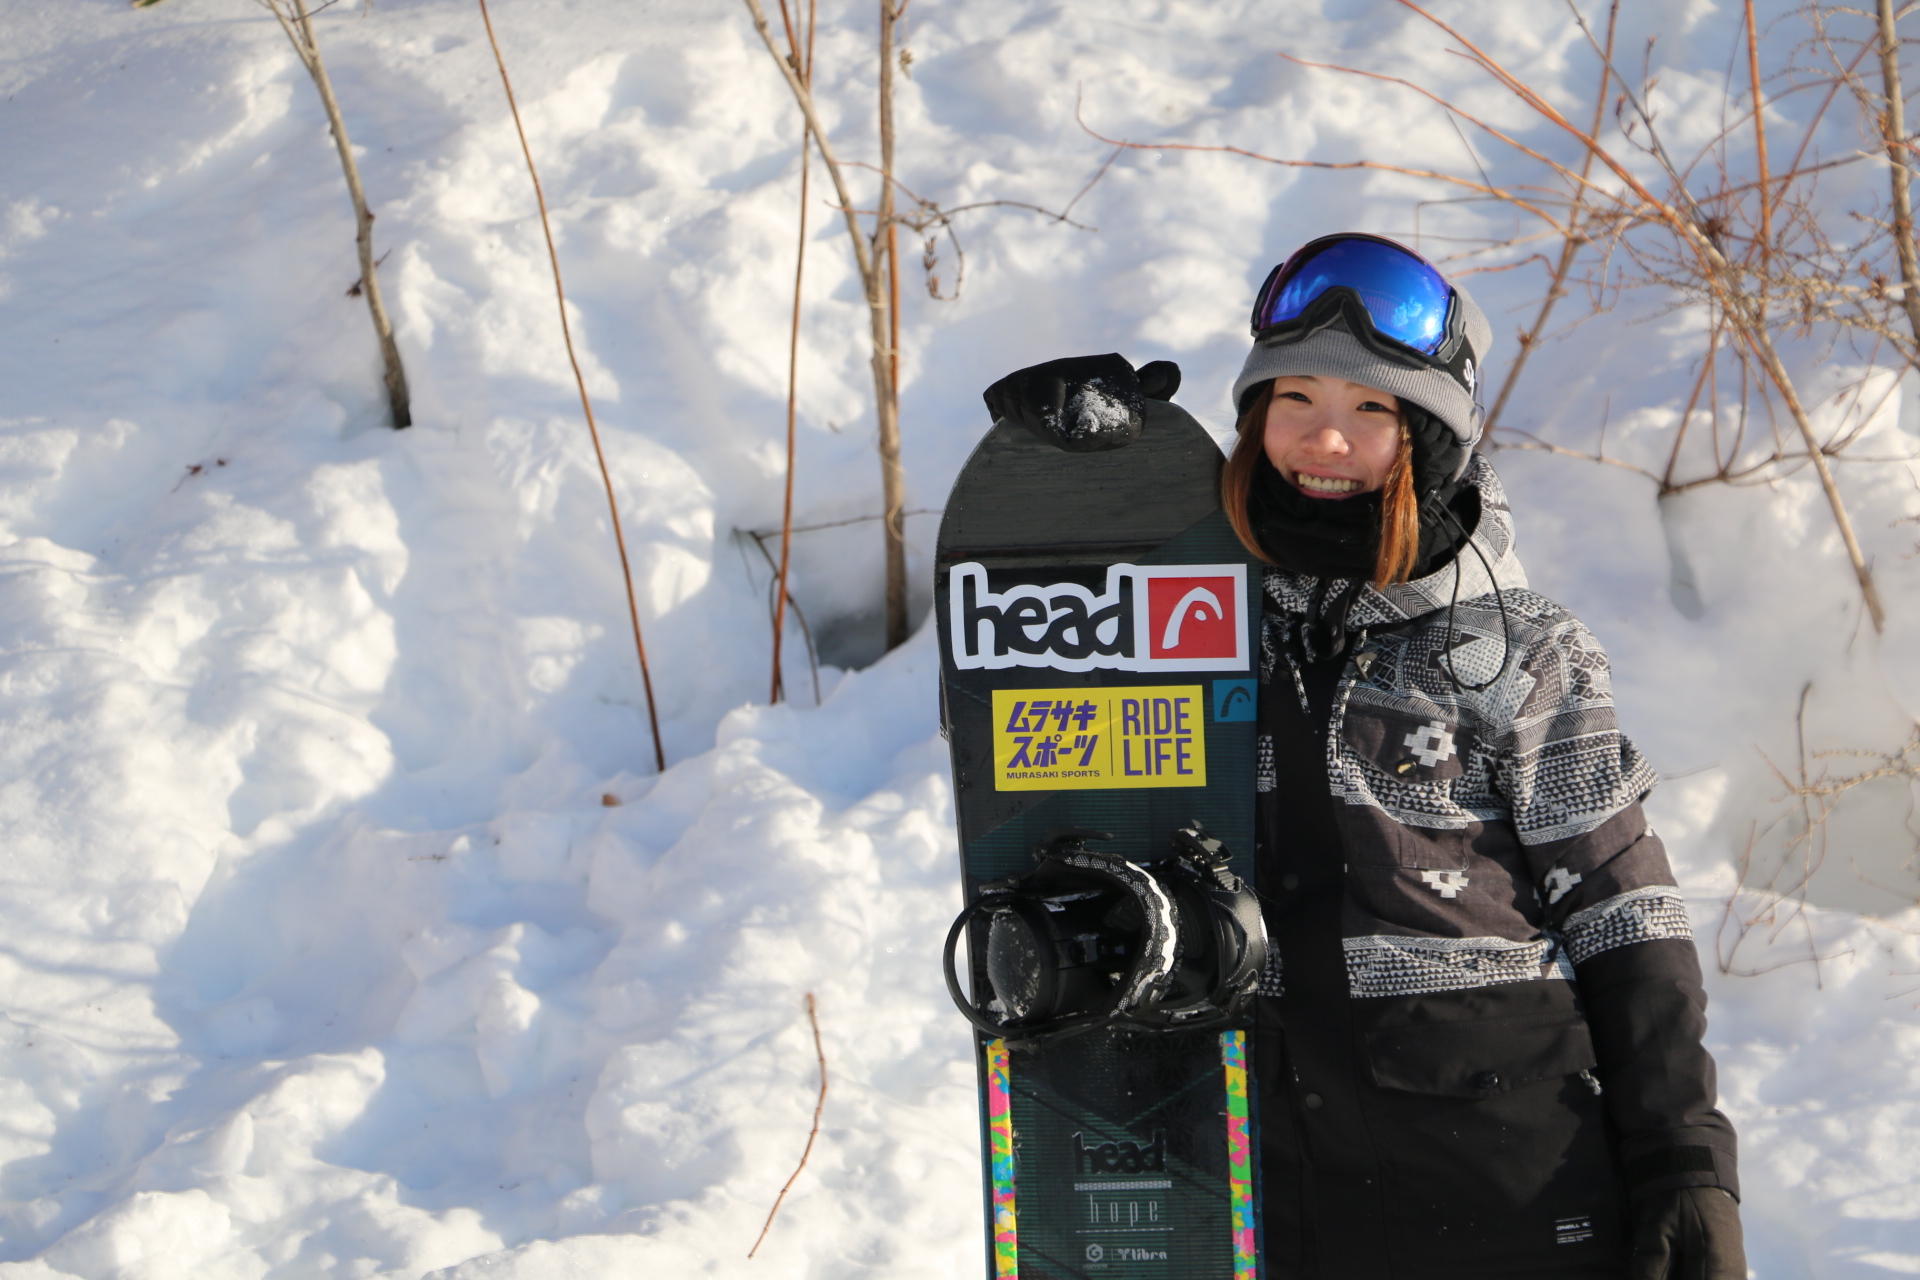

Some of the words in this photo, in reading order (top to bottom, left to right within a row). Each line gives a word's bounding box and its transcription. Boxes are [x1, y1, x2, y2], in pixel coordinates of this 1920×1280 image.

[961, 573, 1136, 660] head
[1005, 699, 1098, 733] ムラサキ
[1121, 697, 1192, 736] RIDE
[1006, 734, 1099, 768] スポーツ
[1123, 737, 1194, 776] LIFE
[1006, 771, 1059, 779] MURASAKI
[1061, 770, 1100, 778] SPORTS
[1072, 1128, 1167, 1174] head
[1090, 1194, 1158, 1227] hope
